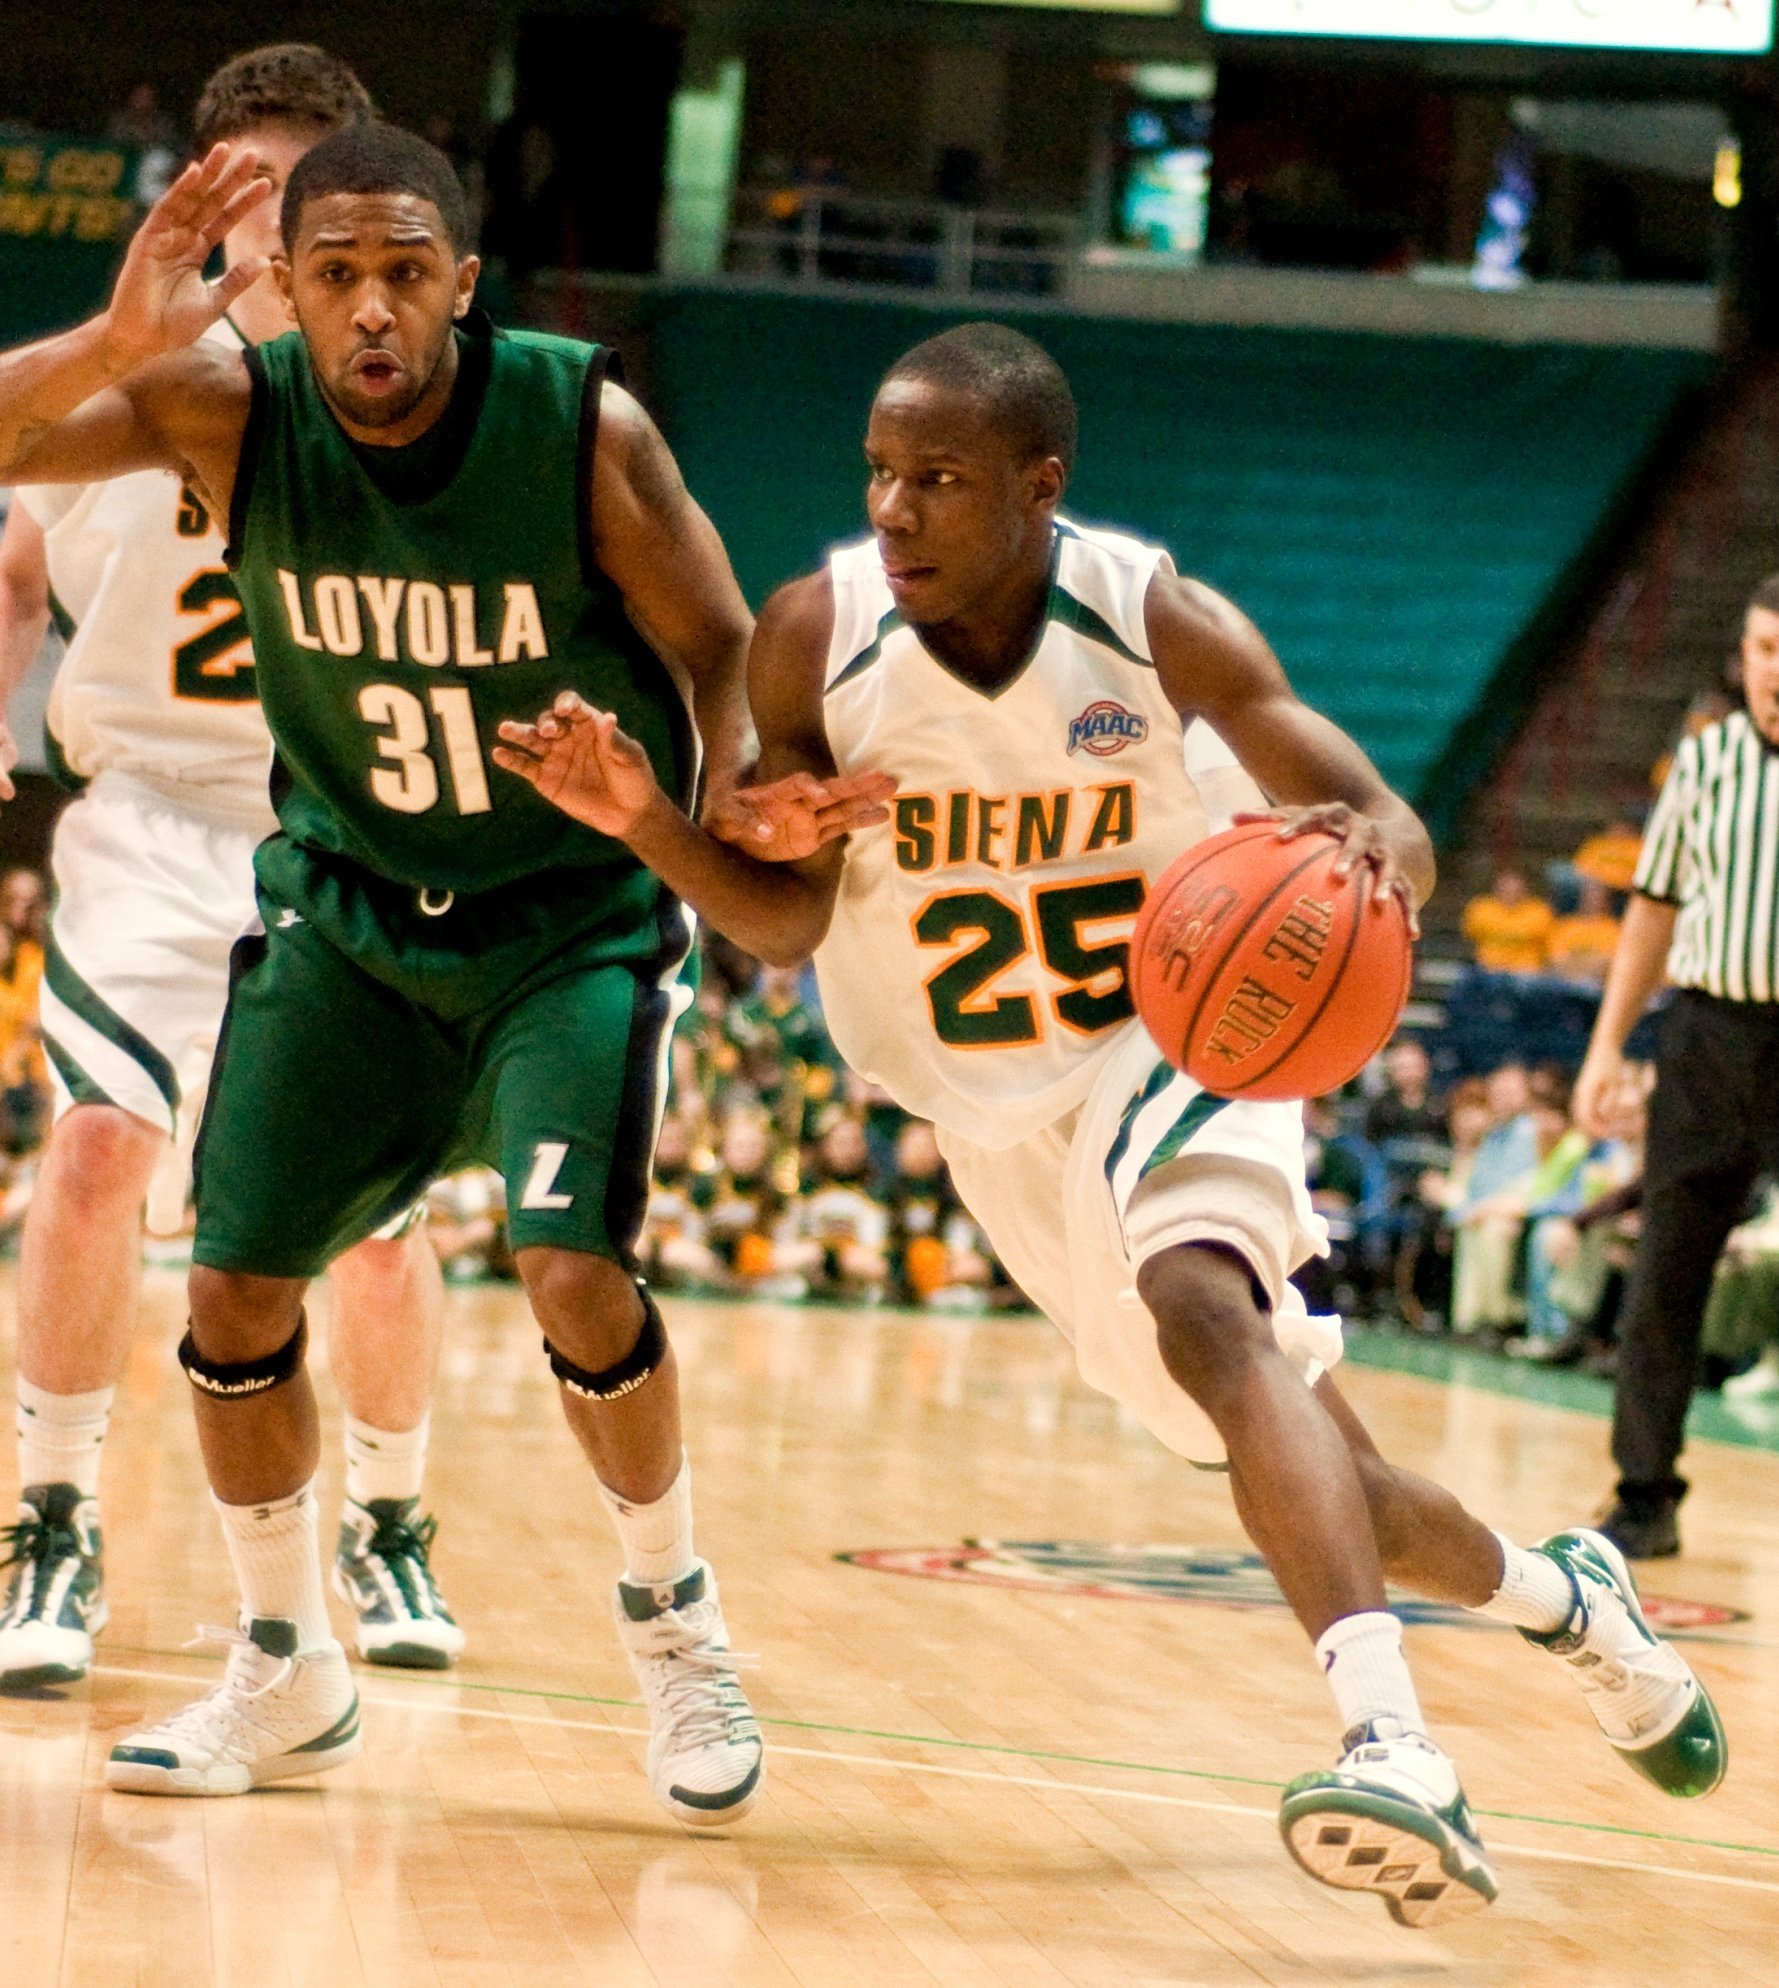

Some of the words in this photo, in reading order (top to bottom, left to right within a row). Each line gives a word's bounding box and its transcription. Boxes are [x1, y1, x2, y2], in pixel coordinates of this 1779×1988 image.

[277, 567, 549, 668] LOYOLA
[357, 683, 492, 816] 31
[1067, 712, 1148, 754] MAAC
[894, 779, 1138, 873] SIENA
[909, 870, 1147, 1052] 25
[1261, 894, 1334, 982] THE
[1205, 975, 1298, 1066] ROCK
[520, 1141, 575, 1210] L
[202, 1374, 276, 1394] Mueller
